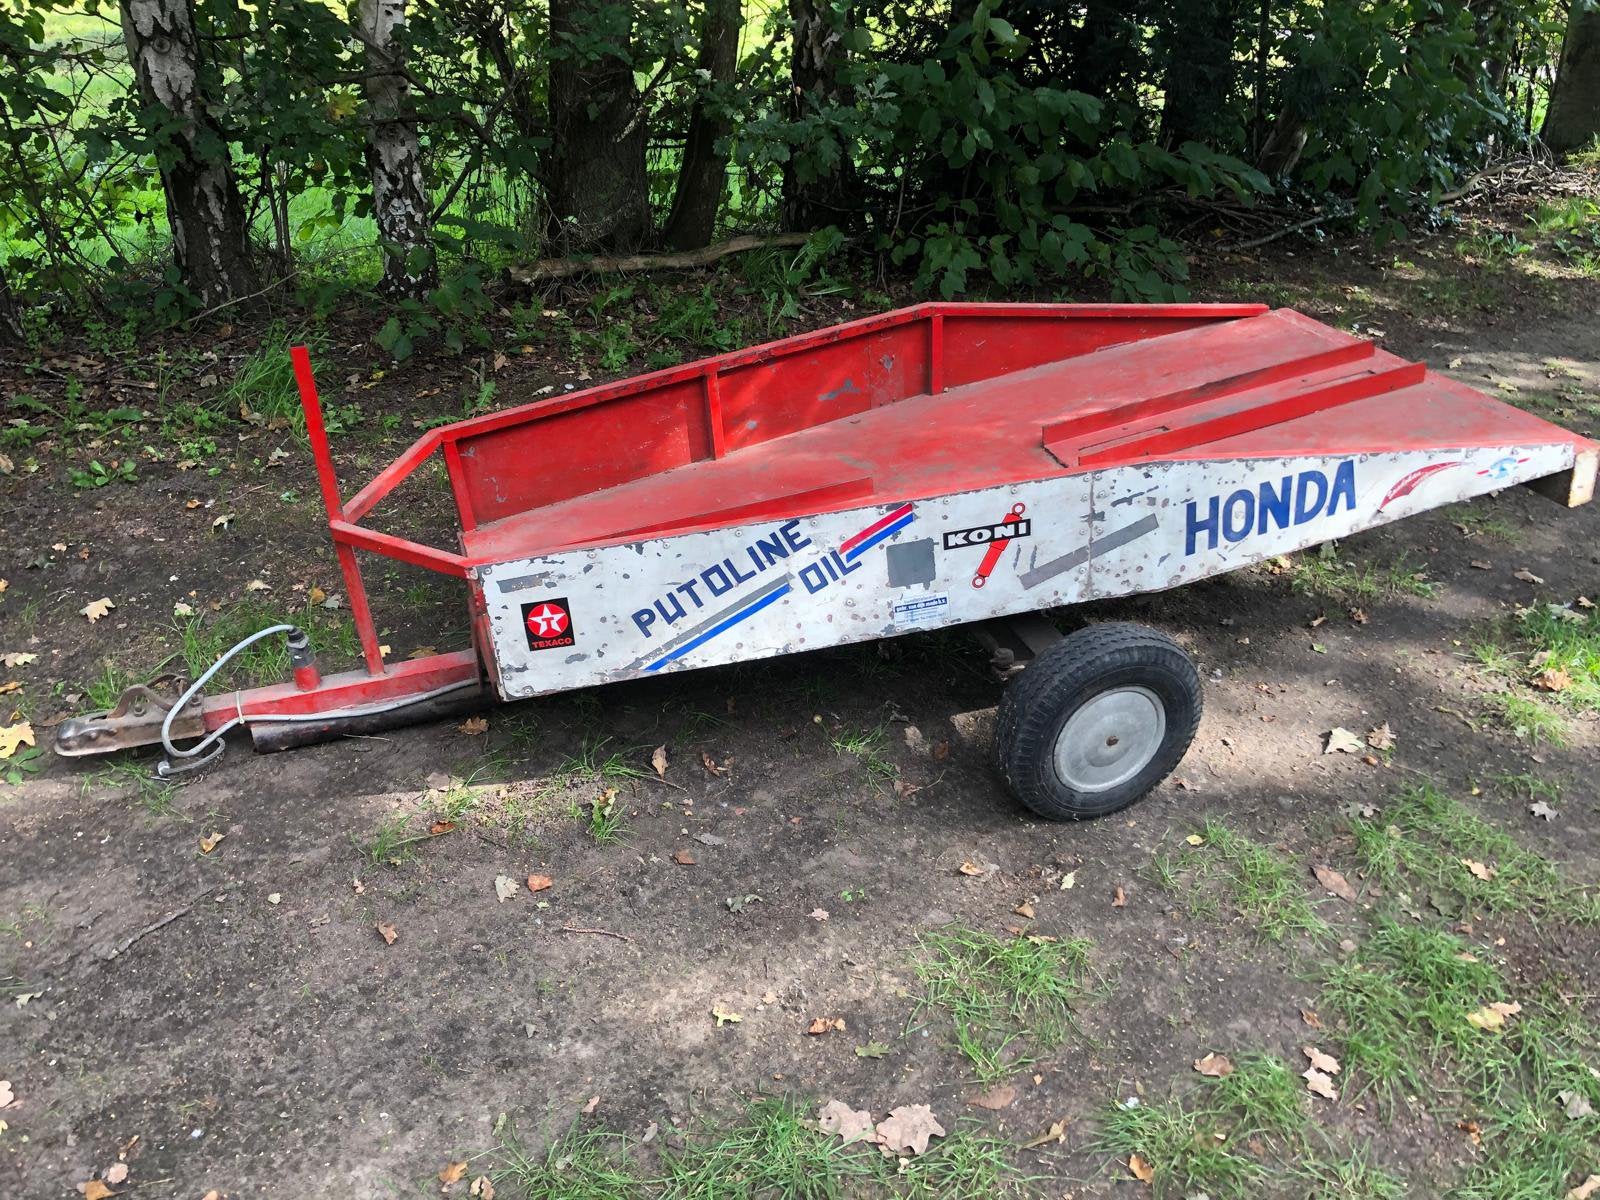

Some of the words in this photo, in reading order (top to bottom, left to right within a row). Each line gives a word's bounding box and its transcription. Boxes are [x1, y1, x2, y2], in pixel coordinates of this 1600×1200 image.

[1185, 459, 1357, 557] HONDA
[948, 522, 1028, 547] KONI
[631, 518, 812, 638] PUTOLINE
[798, 550, 863, 595] OIL
[532, 637, 572, 648] TEXACO
